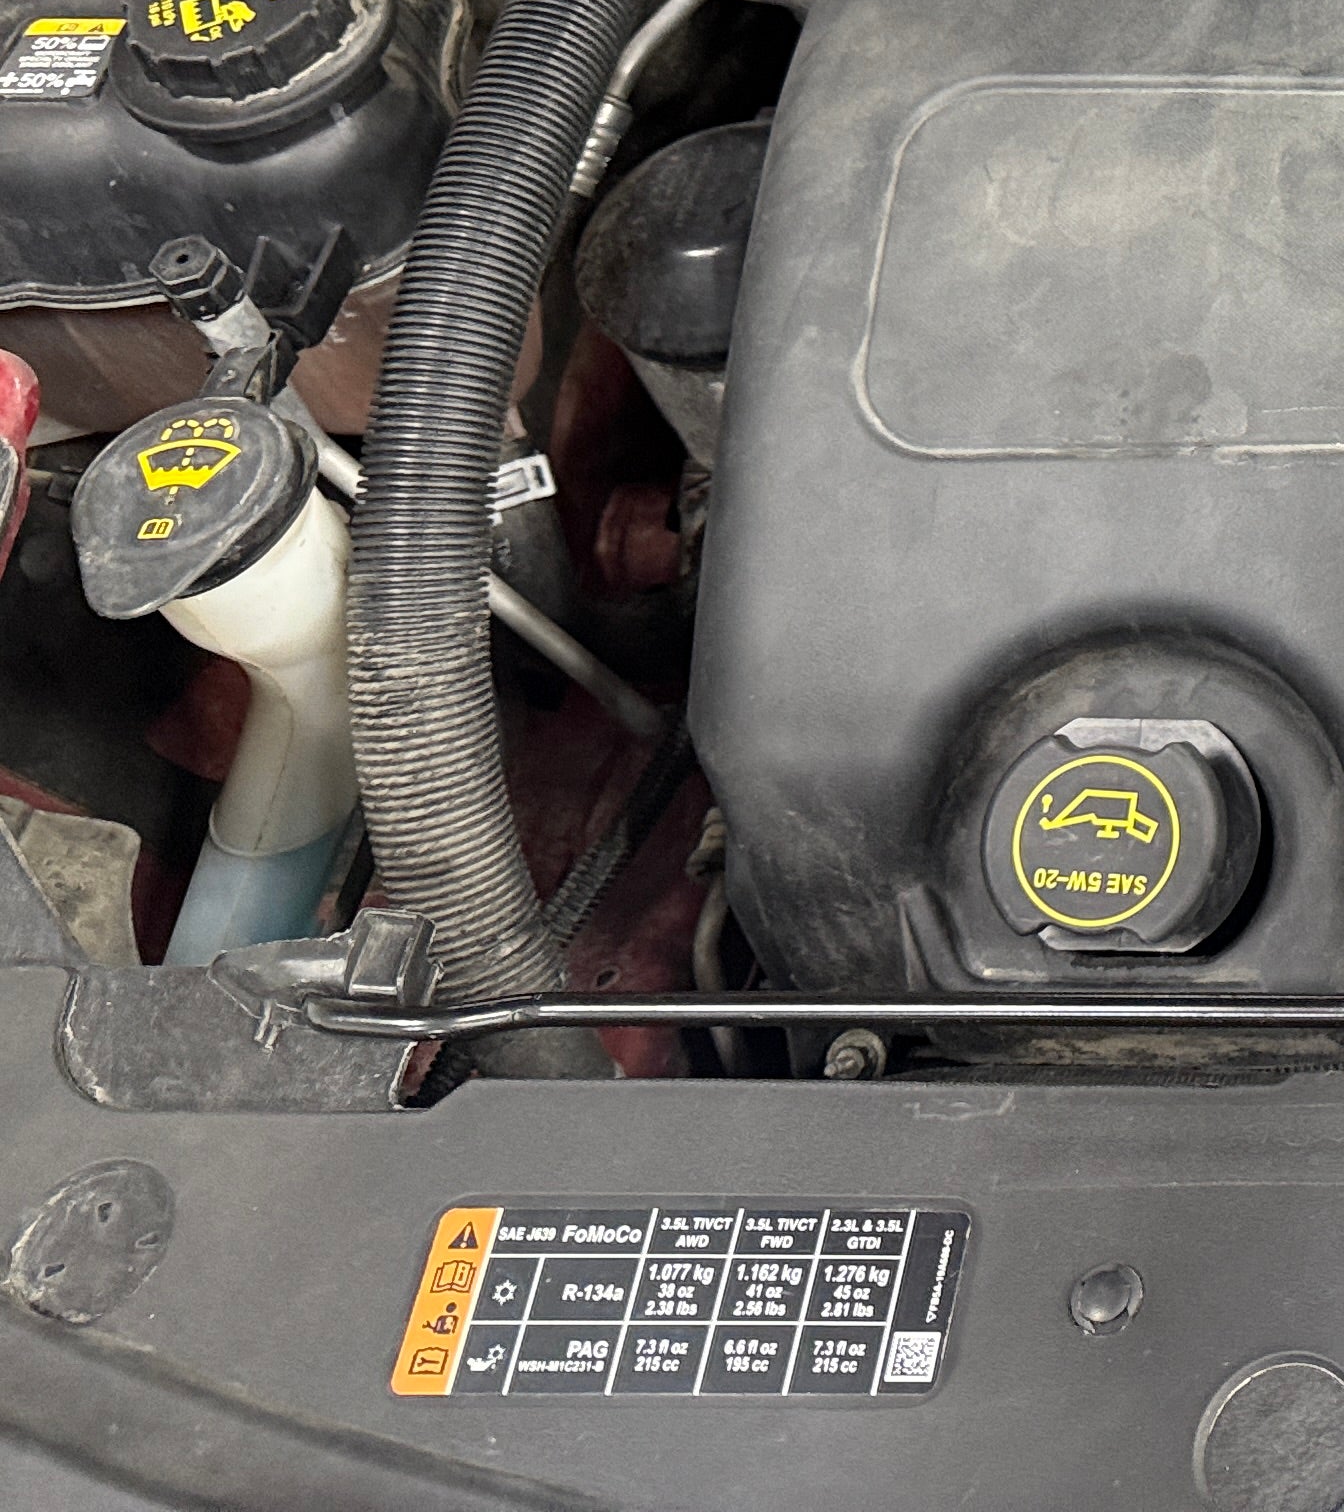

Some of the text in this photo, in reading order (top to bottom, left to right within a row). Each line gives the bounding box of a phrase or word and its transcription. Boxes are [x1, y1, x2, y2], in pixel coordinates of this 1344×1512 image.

[31, 37, 79, 50] 50%
[1033, 868, 1148, 895] SAE 5W-20
[661, 1217, 689, 1231] 3.5L
[745, 1218, 773, 1231] 3.5L
[831, 1219, 904, 1232] 2.3L & 3.5L
[498, 1225, 642, 1243] SAE J639 FoMoCo
[675, 1235, 710, 1248] AWD
[760, 1235, 794, 1248] FWD
[847, 1236, 882, 1249] GTDI
[649, 1263, 715, 1285] 1.077 kg
[737, 1264, 802, 1286] 1.162 kg
[824, 1265, 890, 1287] 1.276 kg
[561, 1284, 624, 1301] R-134a
[658, 1283, 695, 1298] 38 oz
[746, 1284, 784, 1298] 41 oz
[833, 1285, 871, 1300] 45 oz
[645, 1301, 698, 1316] 2.38 lbs
[765, 1301, 786, 1316] lbs
[821, 1302, 874, 1317] 2.81 lbs
[566, 1341, 609, 1358] PAG
[635, 1339, 689, 1355] 7.3 fl oz
[723, 1339, 778, 1355] 6.6 fl oz
[813, 1340, 866, 1356] 7.3 fl oz
[634, 1356, 680, 1372] 215 cc
[726, 1356, 769, 1372] 195 cc
[812, 1357, 858, 1373] 215 cc
